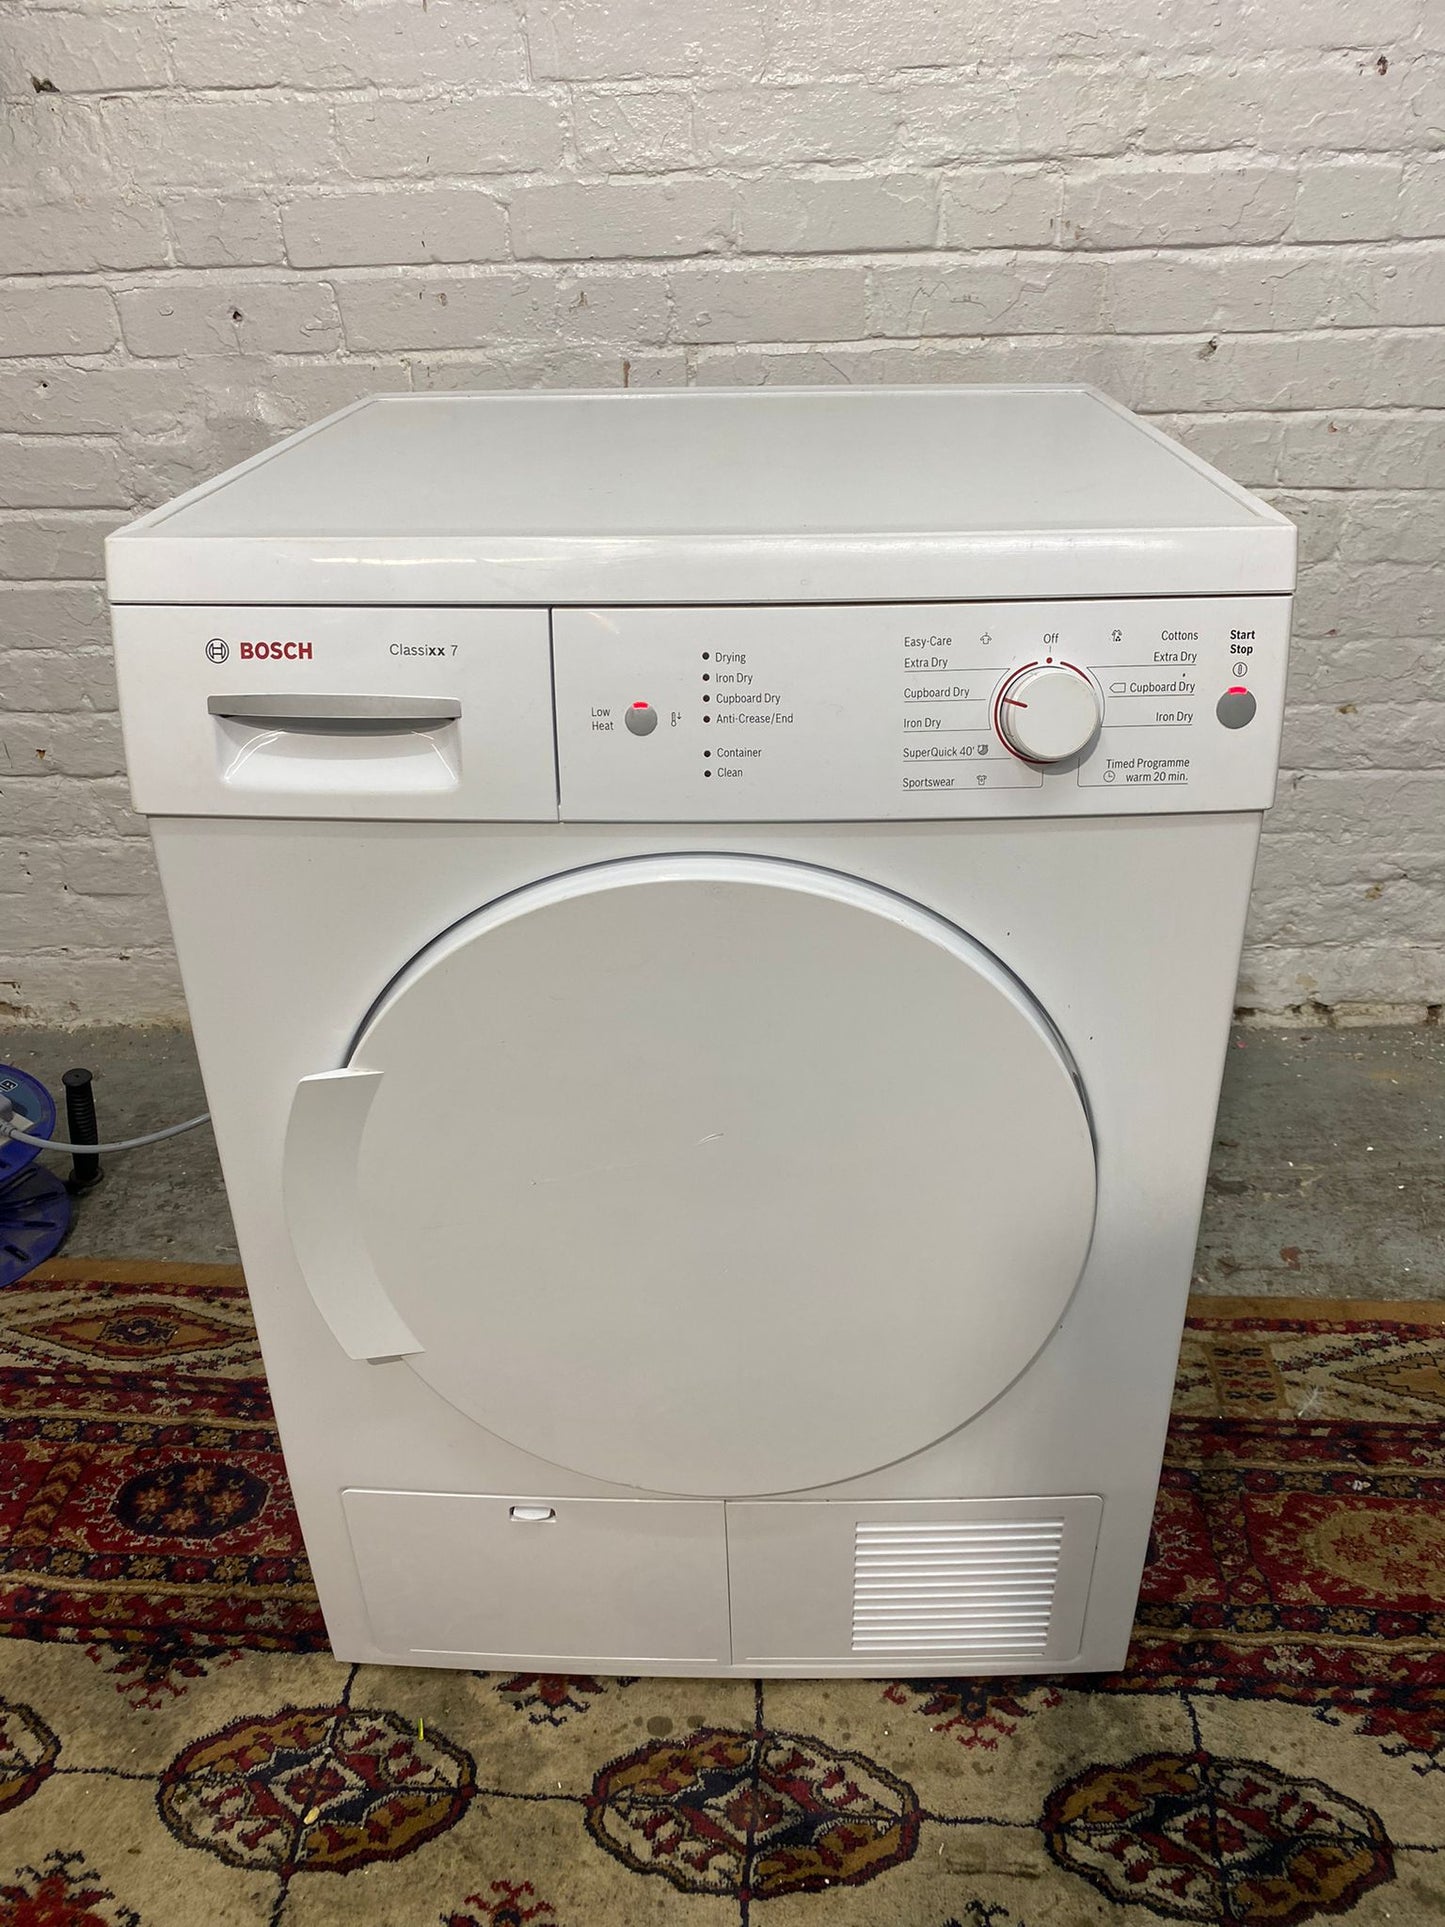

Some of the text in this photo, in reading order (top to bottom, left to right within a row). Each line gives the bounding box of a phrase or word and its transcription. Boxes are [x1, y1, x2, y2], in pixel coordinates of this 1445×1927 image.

[1043, 633, 1059, 644] Off
[1161, 631, 1198, 640] Cottons
[1230, 630, 1255, 640] Start
[904, 636, 952, 648] Easy-Care
[240, 642, 312, 660] BOSCH
[389, 644, 458, 656] Classixx 7
[1230, 644, 1253, 656] Stop
[715, 652, 746, 664] Drying
[904, 657, 948, 669] Extra Dry
[1154, 651, 1197, 663] Extra Dry
[716, 673, 753, 684] Iron Dry
[904, 687, 970, 699] Cupboard Dry
[1130, 681, 1195, 693] Cupboard Dry
[716, 694, 781, 705] Cupboard Dry
[591, 708, 610, 717] Low
[1156, 711, 1193, 723] Iron Dry
[716, 713, 793, 725] Anti-Crease/End
[904, 718, 941, 729] Iron Dry
[592, 721, 614, 731] Heat
[717, 748, 762, 758] Container
[903, 746, 957, 759] SuperQuick
[1106, 758, 1189, 770] Timed Programme
[717, 768, 743, 778] Clean
[1126, 772, 1188, 782] warm 20 min.
[903, 777, 954, 788] Sportswear
